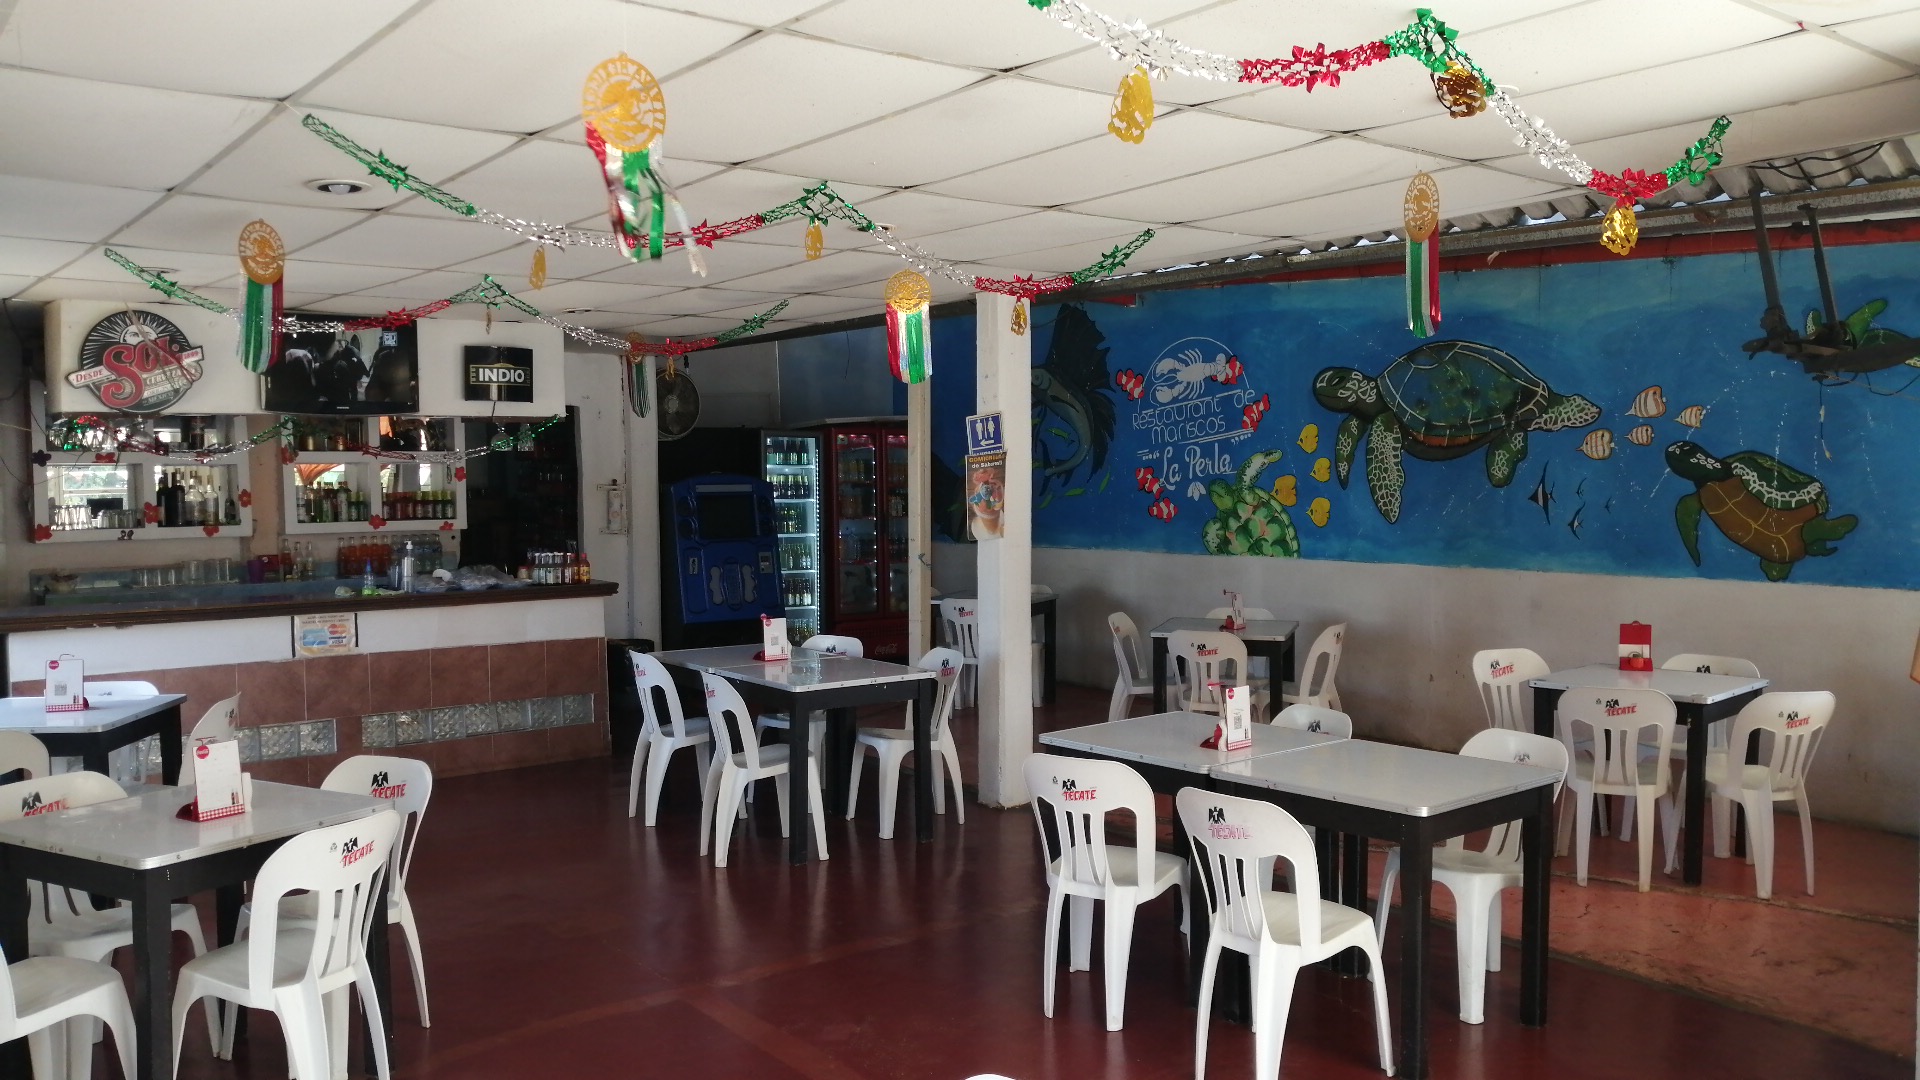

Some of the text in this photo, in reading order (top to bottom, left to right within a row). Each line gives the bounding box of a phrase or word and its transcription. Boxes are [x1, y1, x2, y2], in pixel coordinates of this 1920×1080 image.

[75, 368, 103, 383] DESDE
[479, 368, 525, 383] INDIO
[1234, 388, 1256, 408] de
[1185, 442, 1238, 480] Perla
[1197, 649, 1219, 657] TECATE
[1603, 705, 1638, 717] TECATE
[369, 783, 407, 800] TECATE
[1062, 789, 1098, 801] TECATE
[340, 842, 375, 868] TECATE
